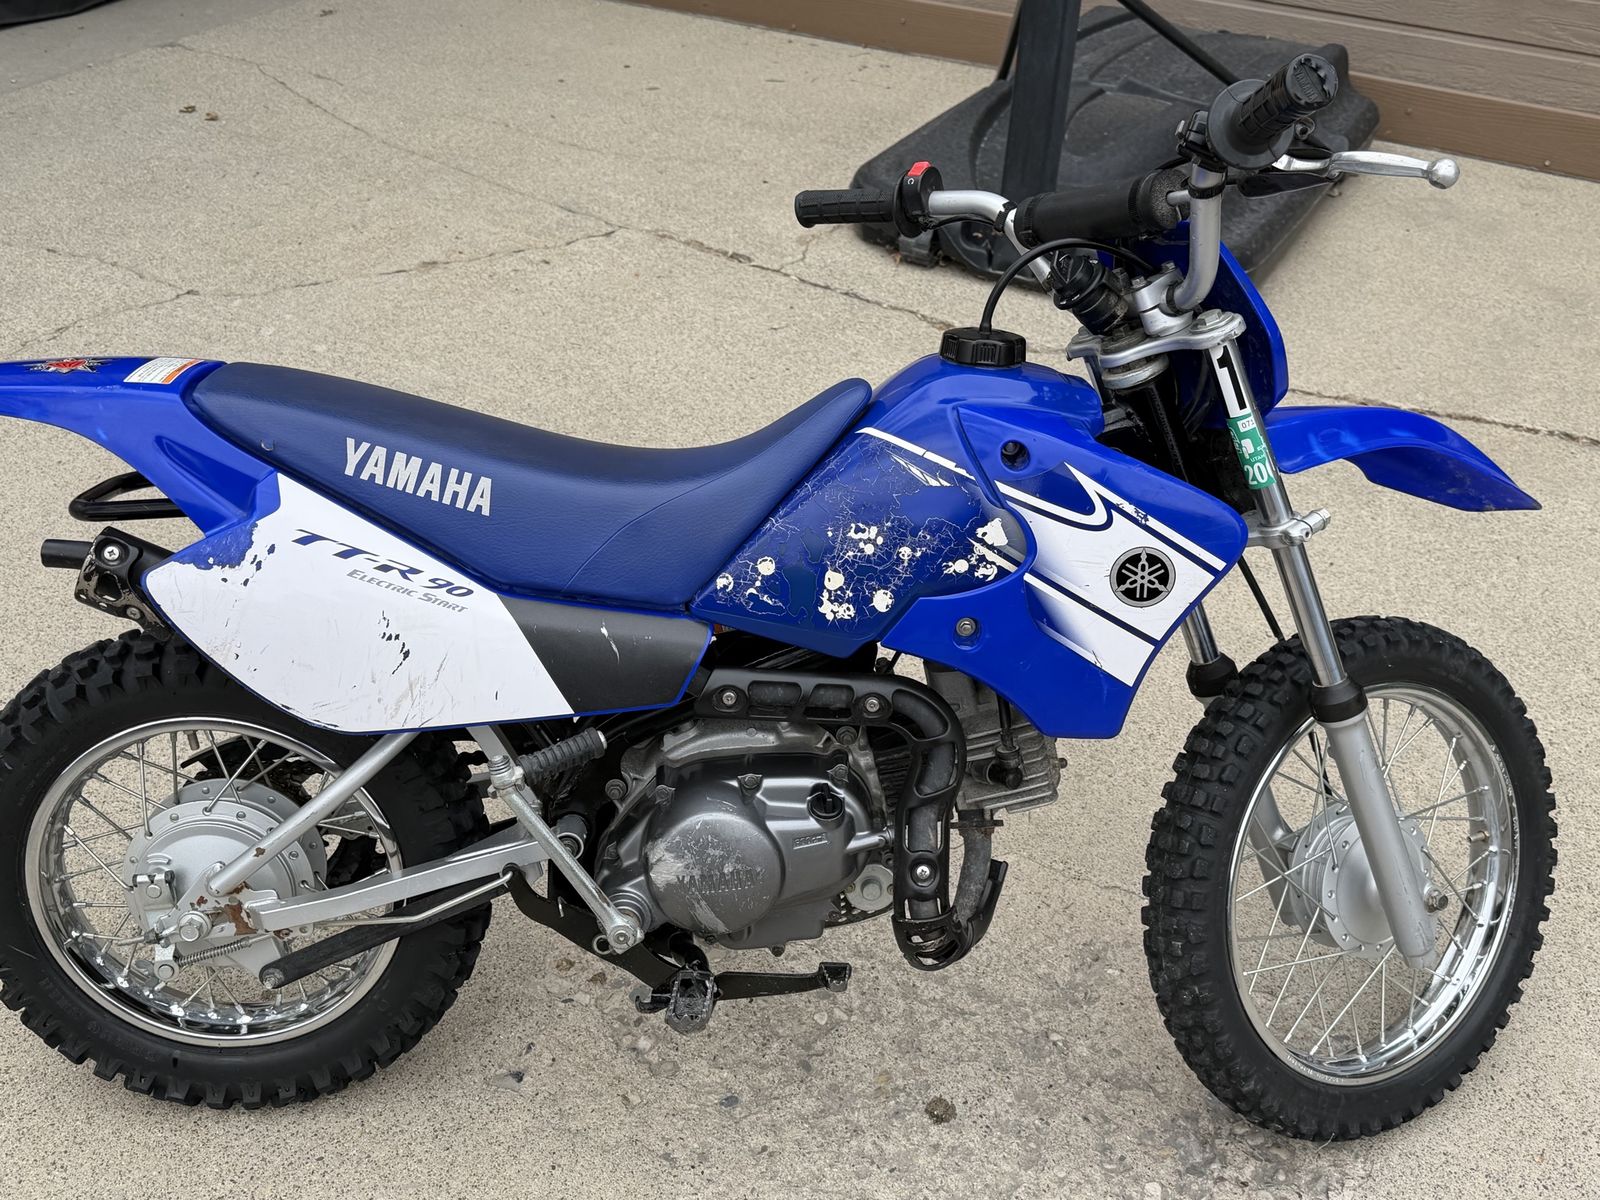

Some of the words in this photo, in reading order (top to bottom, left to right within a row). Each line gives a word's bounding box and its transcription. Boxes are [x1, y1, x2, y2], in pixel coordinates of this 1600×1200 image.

[1217, 345, 1247, 411] 1
[344, 437, 493, 517] YAMAHA
[291, 528, 424, 582] TT-R
[420, 577, 474, 598] 90
[346, 568, 420, 598] ELECTRIC
[418, 592, 468, 613] START
